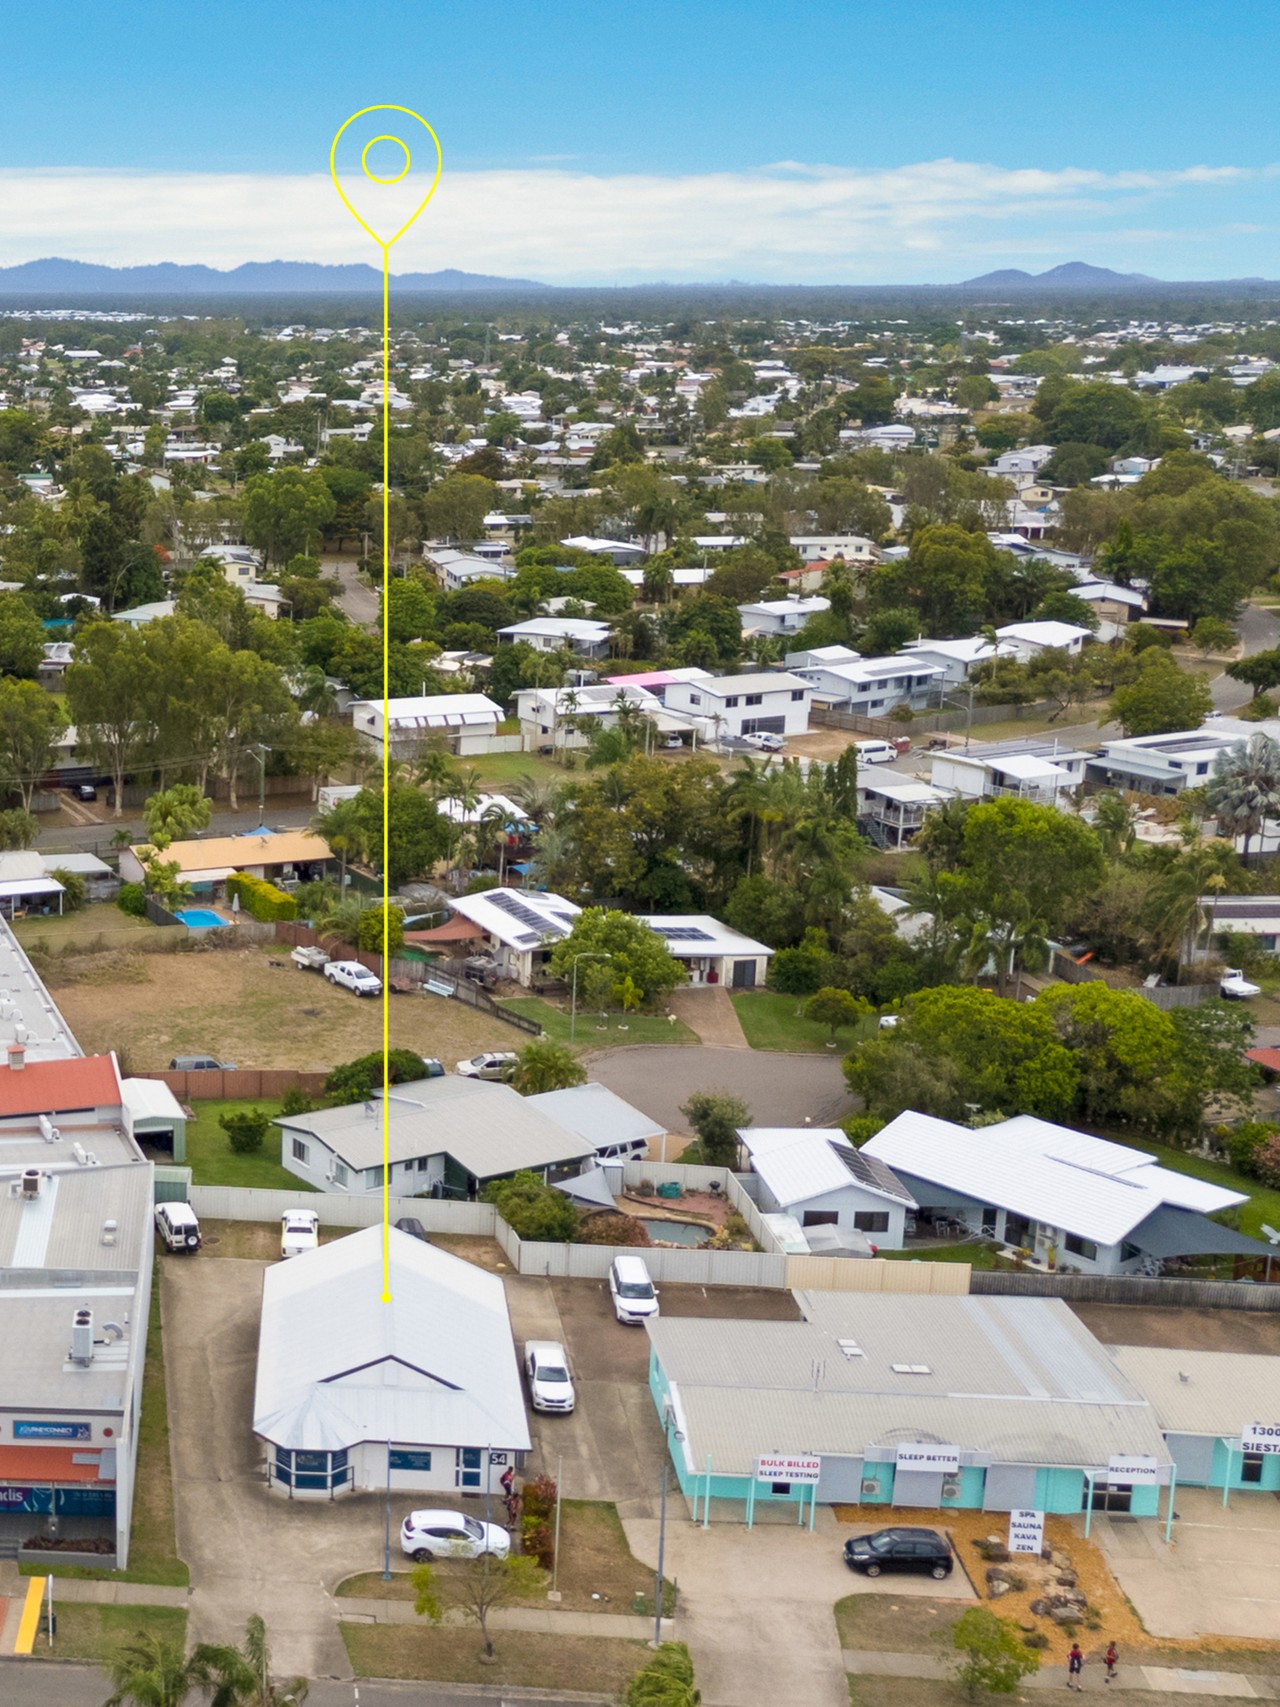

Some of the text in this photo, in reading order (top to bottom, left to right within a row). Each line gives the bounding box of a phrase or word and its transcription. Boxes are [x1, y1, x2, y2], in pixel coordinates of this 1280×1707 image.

[1251, 1426, 1280, 1436] 1300
[1242, 1442, 1280, 1452] SIEST
[491, 1454, 506, 1464] 54
[787, 1461, 819, 1469] BILLED
[785, 1471, 819, 1479] TESTING
[1011, 1521, 1042, 1529] SAUNA
